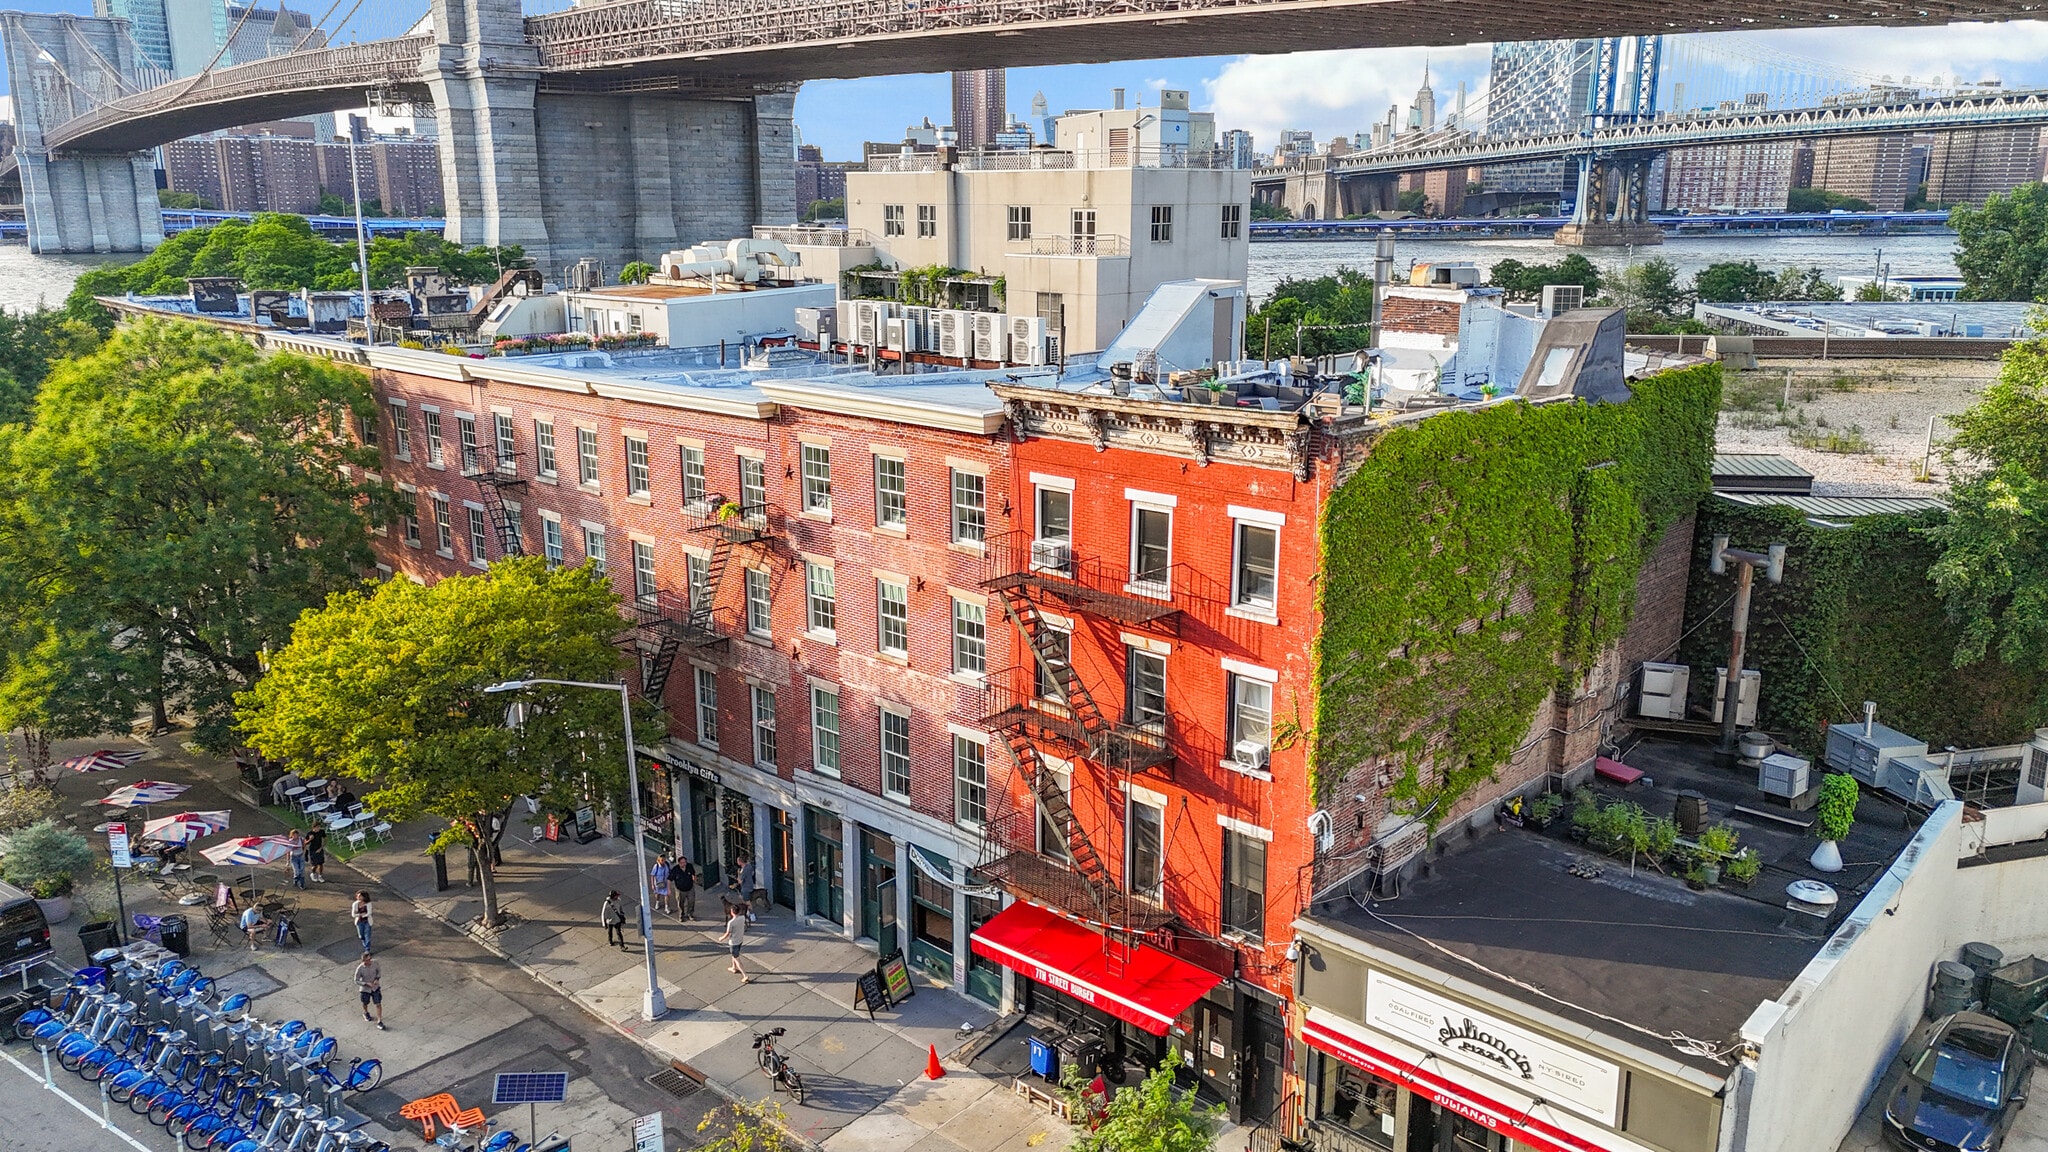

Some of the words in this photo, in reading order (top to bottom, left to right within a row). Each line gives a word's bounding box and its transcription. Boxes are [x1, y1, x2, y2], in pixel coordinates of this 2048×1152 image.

[665, 754, 699, 775] Brooklyn
[699, 768, 719, 783] Gifts
[1035, 967, 1047, 982] 7TH
[1048, 973, 1069, 991] STREET
[1070, 982, 1095, 1003] BURGER
[1085, 1053, 1095, 1065] 17
[1438, 1016, 1534, 1081] Juliana's
[1458, 1041, 1512, 1071] PIZZA
[1433, 1094, 1497, 1128] JULIANA'S
